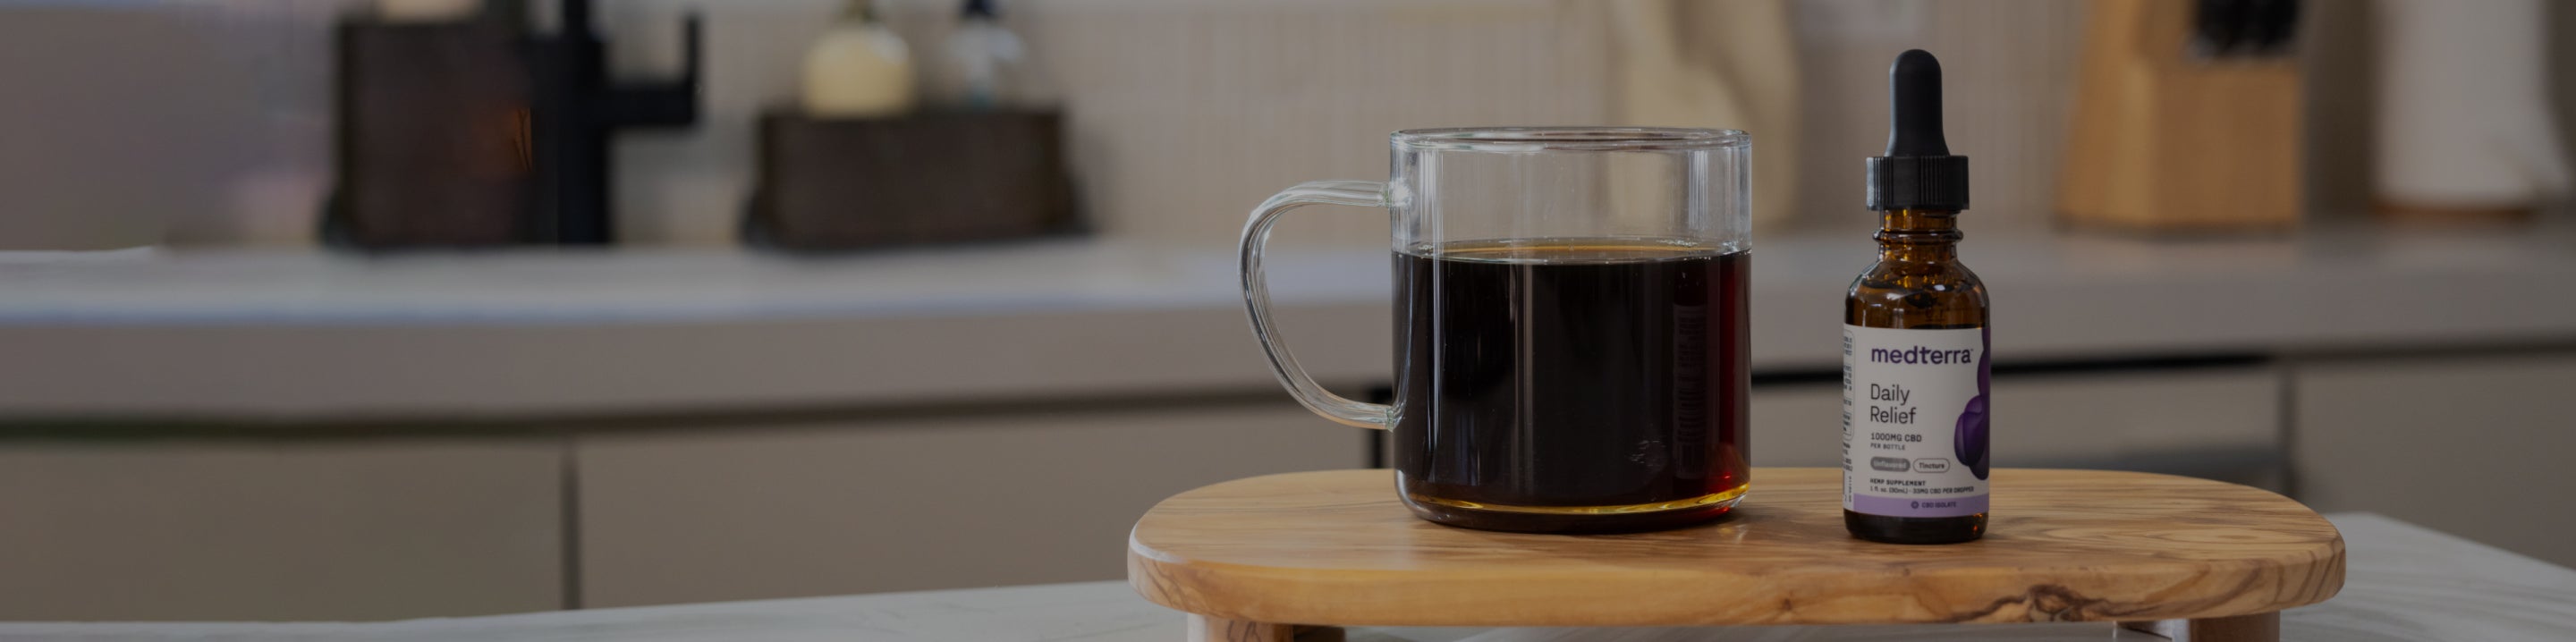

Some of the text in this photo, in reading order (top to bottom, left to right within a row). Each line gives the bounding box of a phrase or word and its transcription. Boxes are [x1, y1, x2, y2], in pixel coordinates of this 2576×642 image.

[1871, 346, 1971, 364] medterra
[1871, 384, 1911, 406] Daily
[1870, 406, 1917, 424] Relief
[1871, 433, 1922, 443] 1000MG CBD
